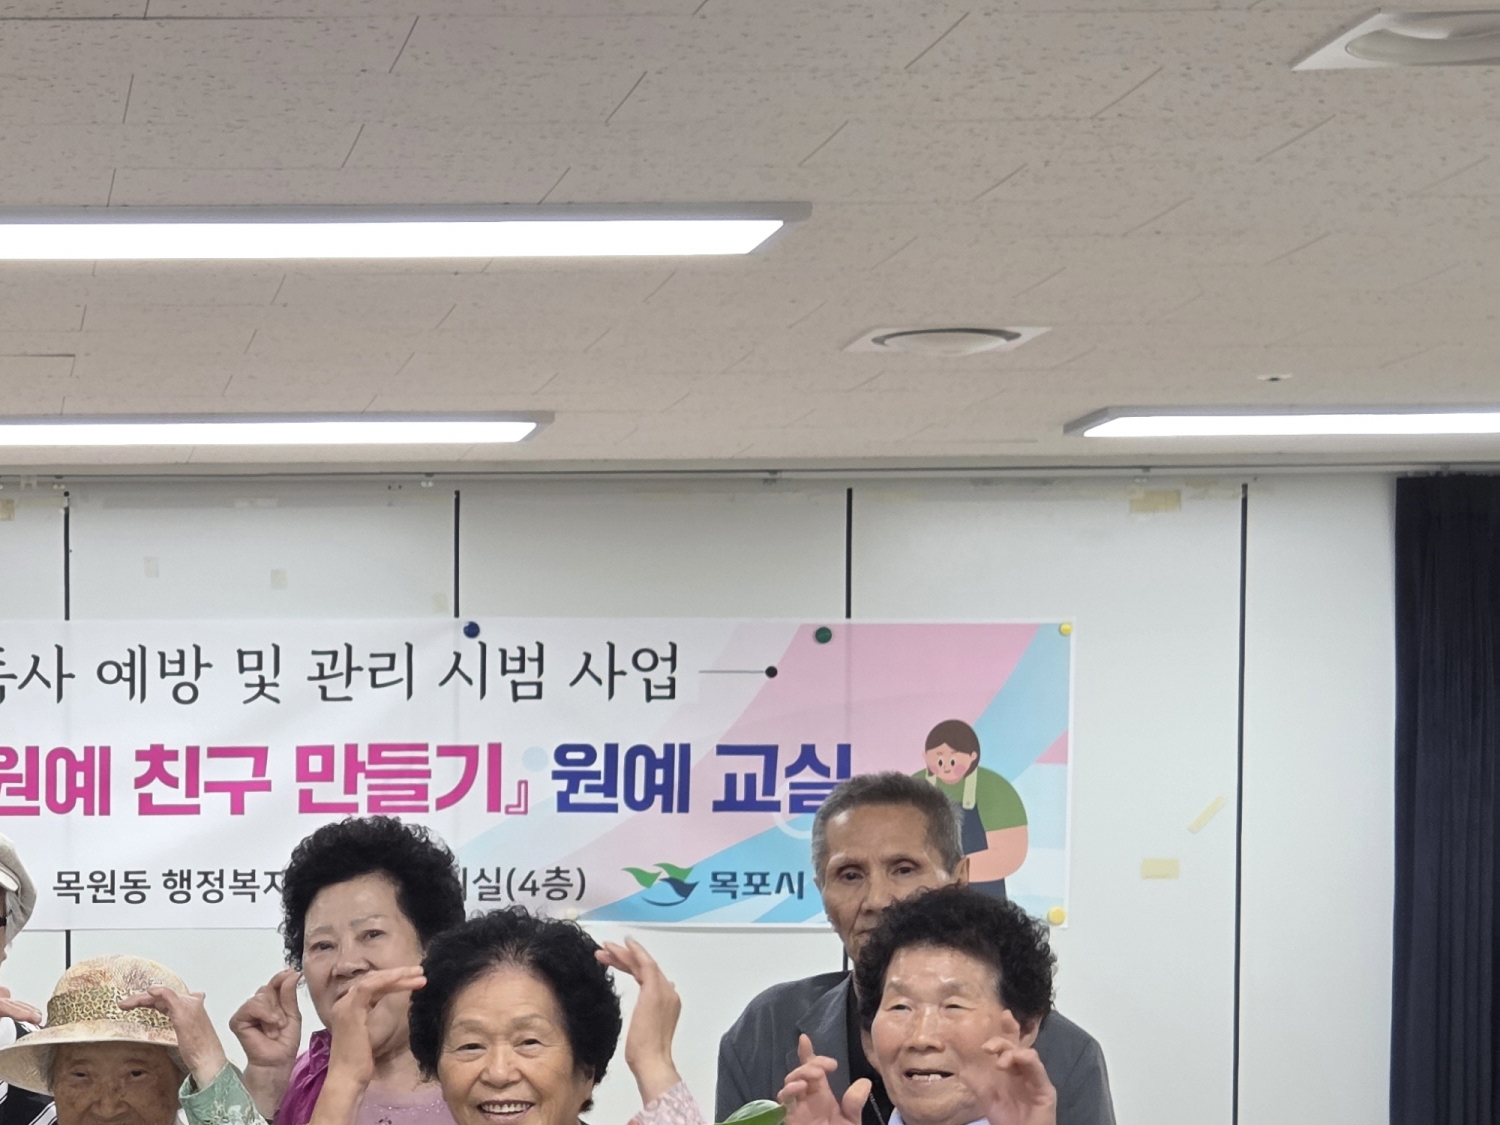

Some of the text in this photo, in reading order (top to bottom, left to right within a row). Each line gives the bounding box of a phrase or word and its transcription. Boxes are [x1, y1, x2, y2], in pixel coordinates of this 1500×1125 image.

[96, 642, 213, 706] 예방
[236, 642, 282, 706] 및
[306, 641, 413, 703] 관리
[437, 641, 545, 704] 시범
[568, 640, 679, 704] 사업
[133, 743, 273, 817] 친구
[295, 742, 529, 816] 만들기』
[551, 742, 692, 814] 원예
[711, 743, 853, 815] 교실
[52, 869, 152, 905] 목원동
[461, 866, 586, 902] 실(4층)
[708, 870, 805, 901] 목포시
